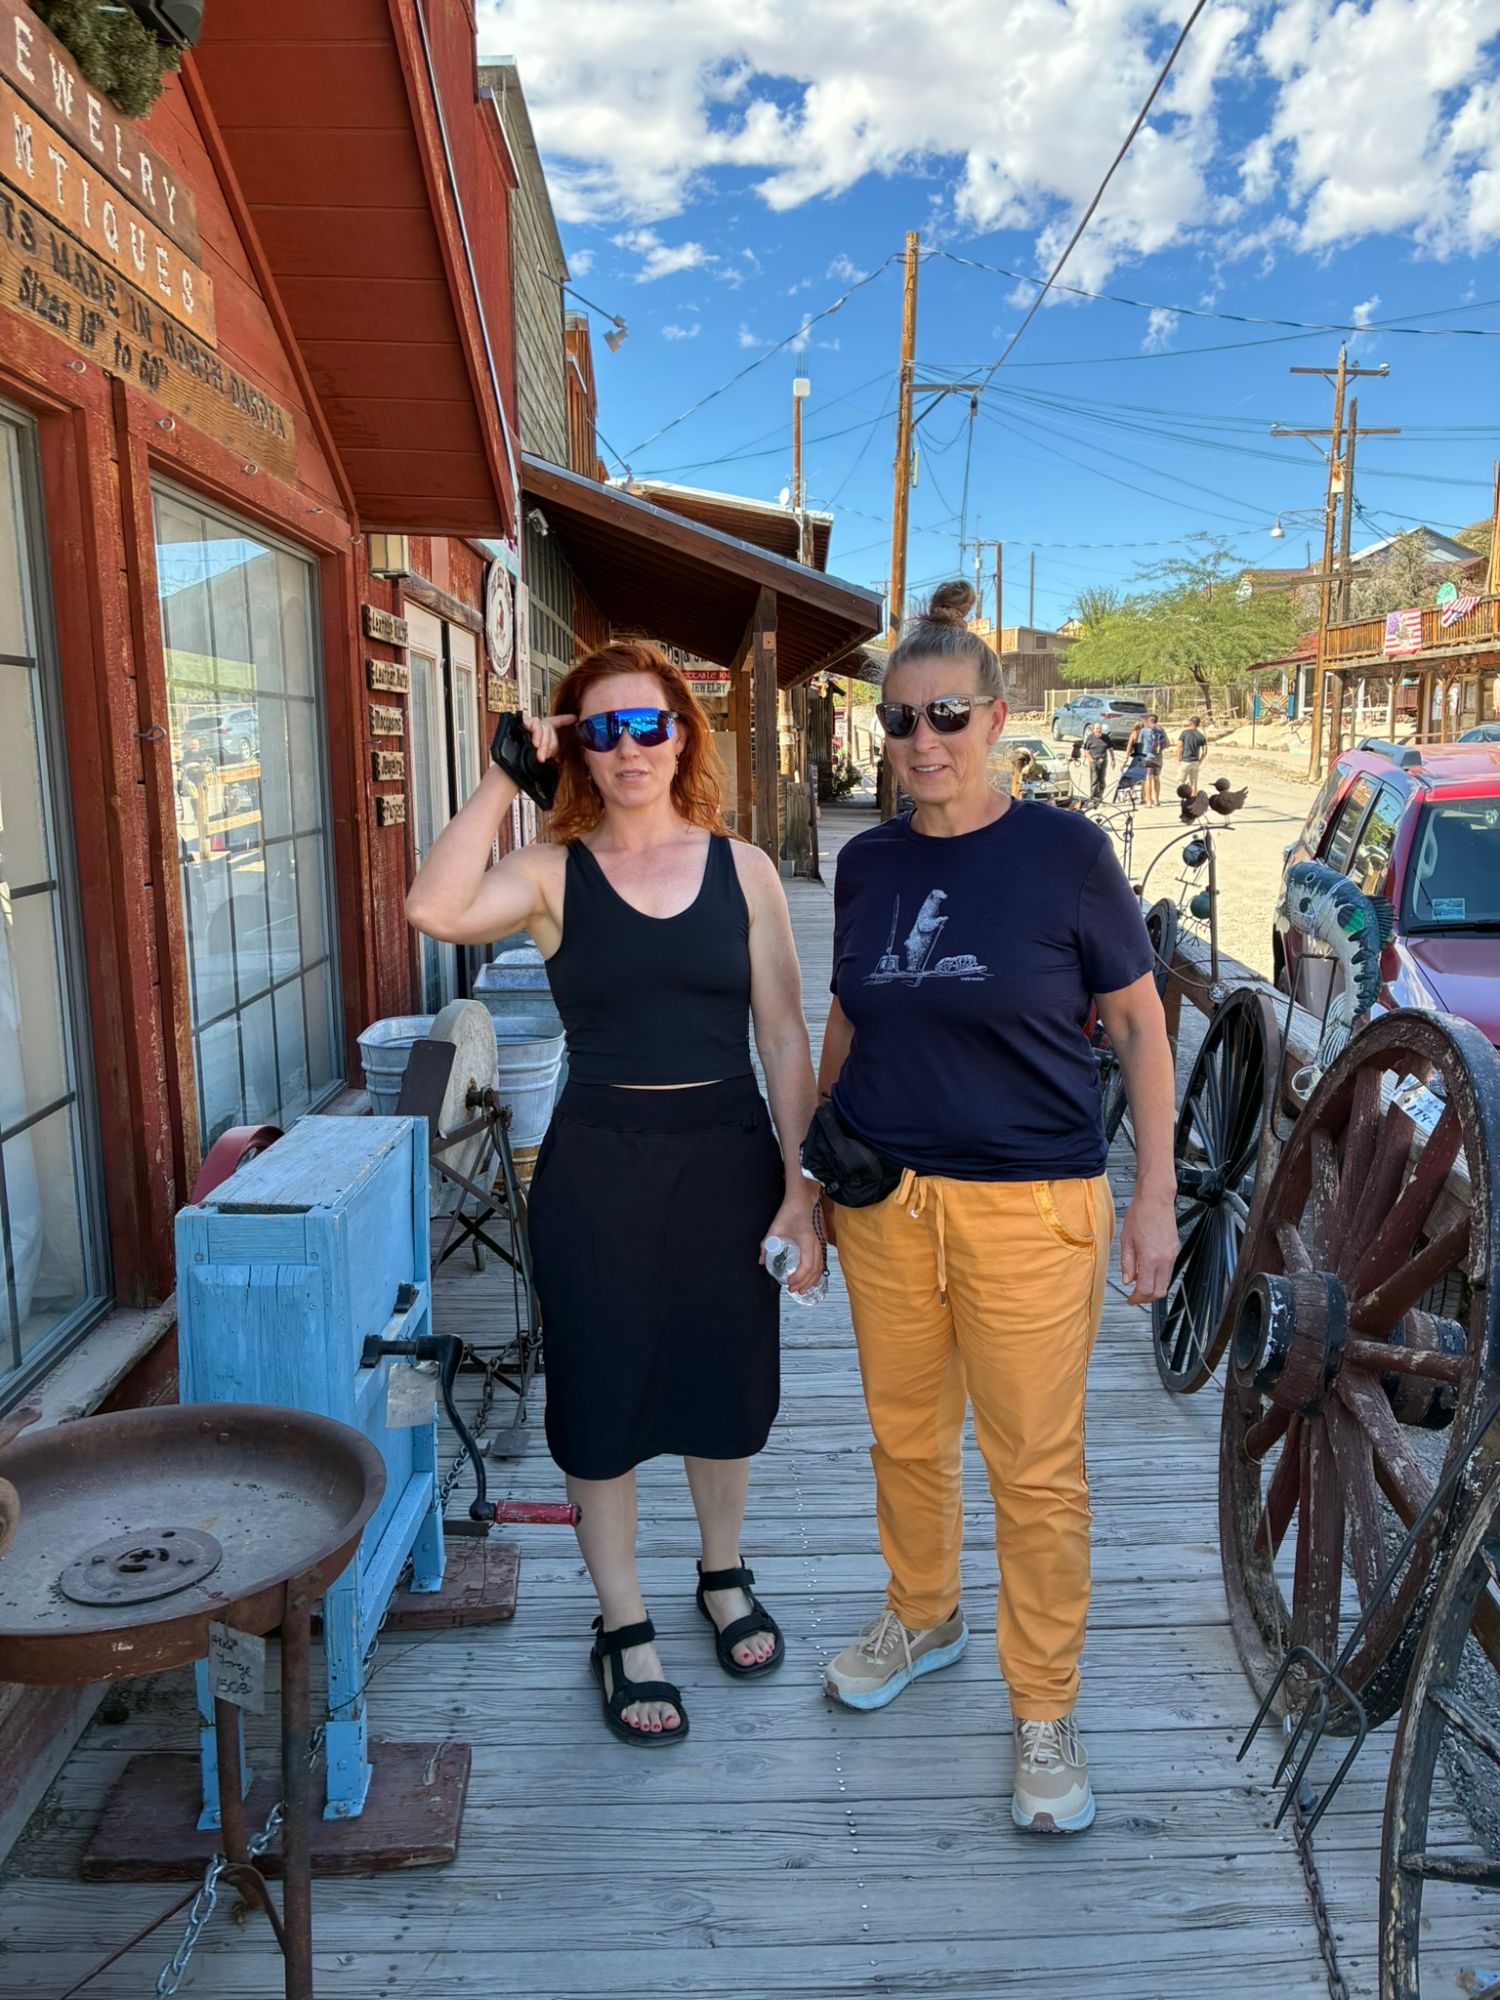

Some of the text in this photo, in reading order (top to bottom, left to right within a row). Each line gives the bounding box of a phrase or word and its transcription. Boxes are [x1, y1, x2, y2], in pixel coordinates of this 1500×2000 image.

[13, 111, 194, 315] NTIQUES
[14, 15, 177, 226] EWELRY
[19, 265, 71, 333] Sizes
[114, 329, 132, 372] to
[49, 230, 120, 319] MADE
[128, 293, 153, 343] IN
[162, 320, 225, 397] NORTH
[229, 373, 287, 441] DAKOTA
